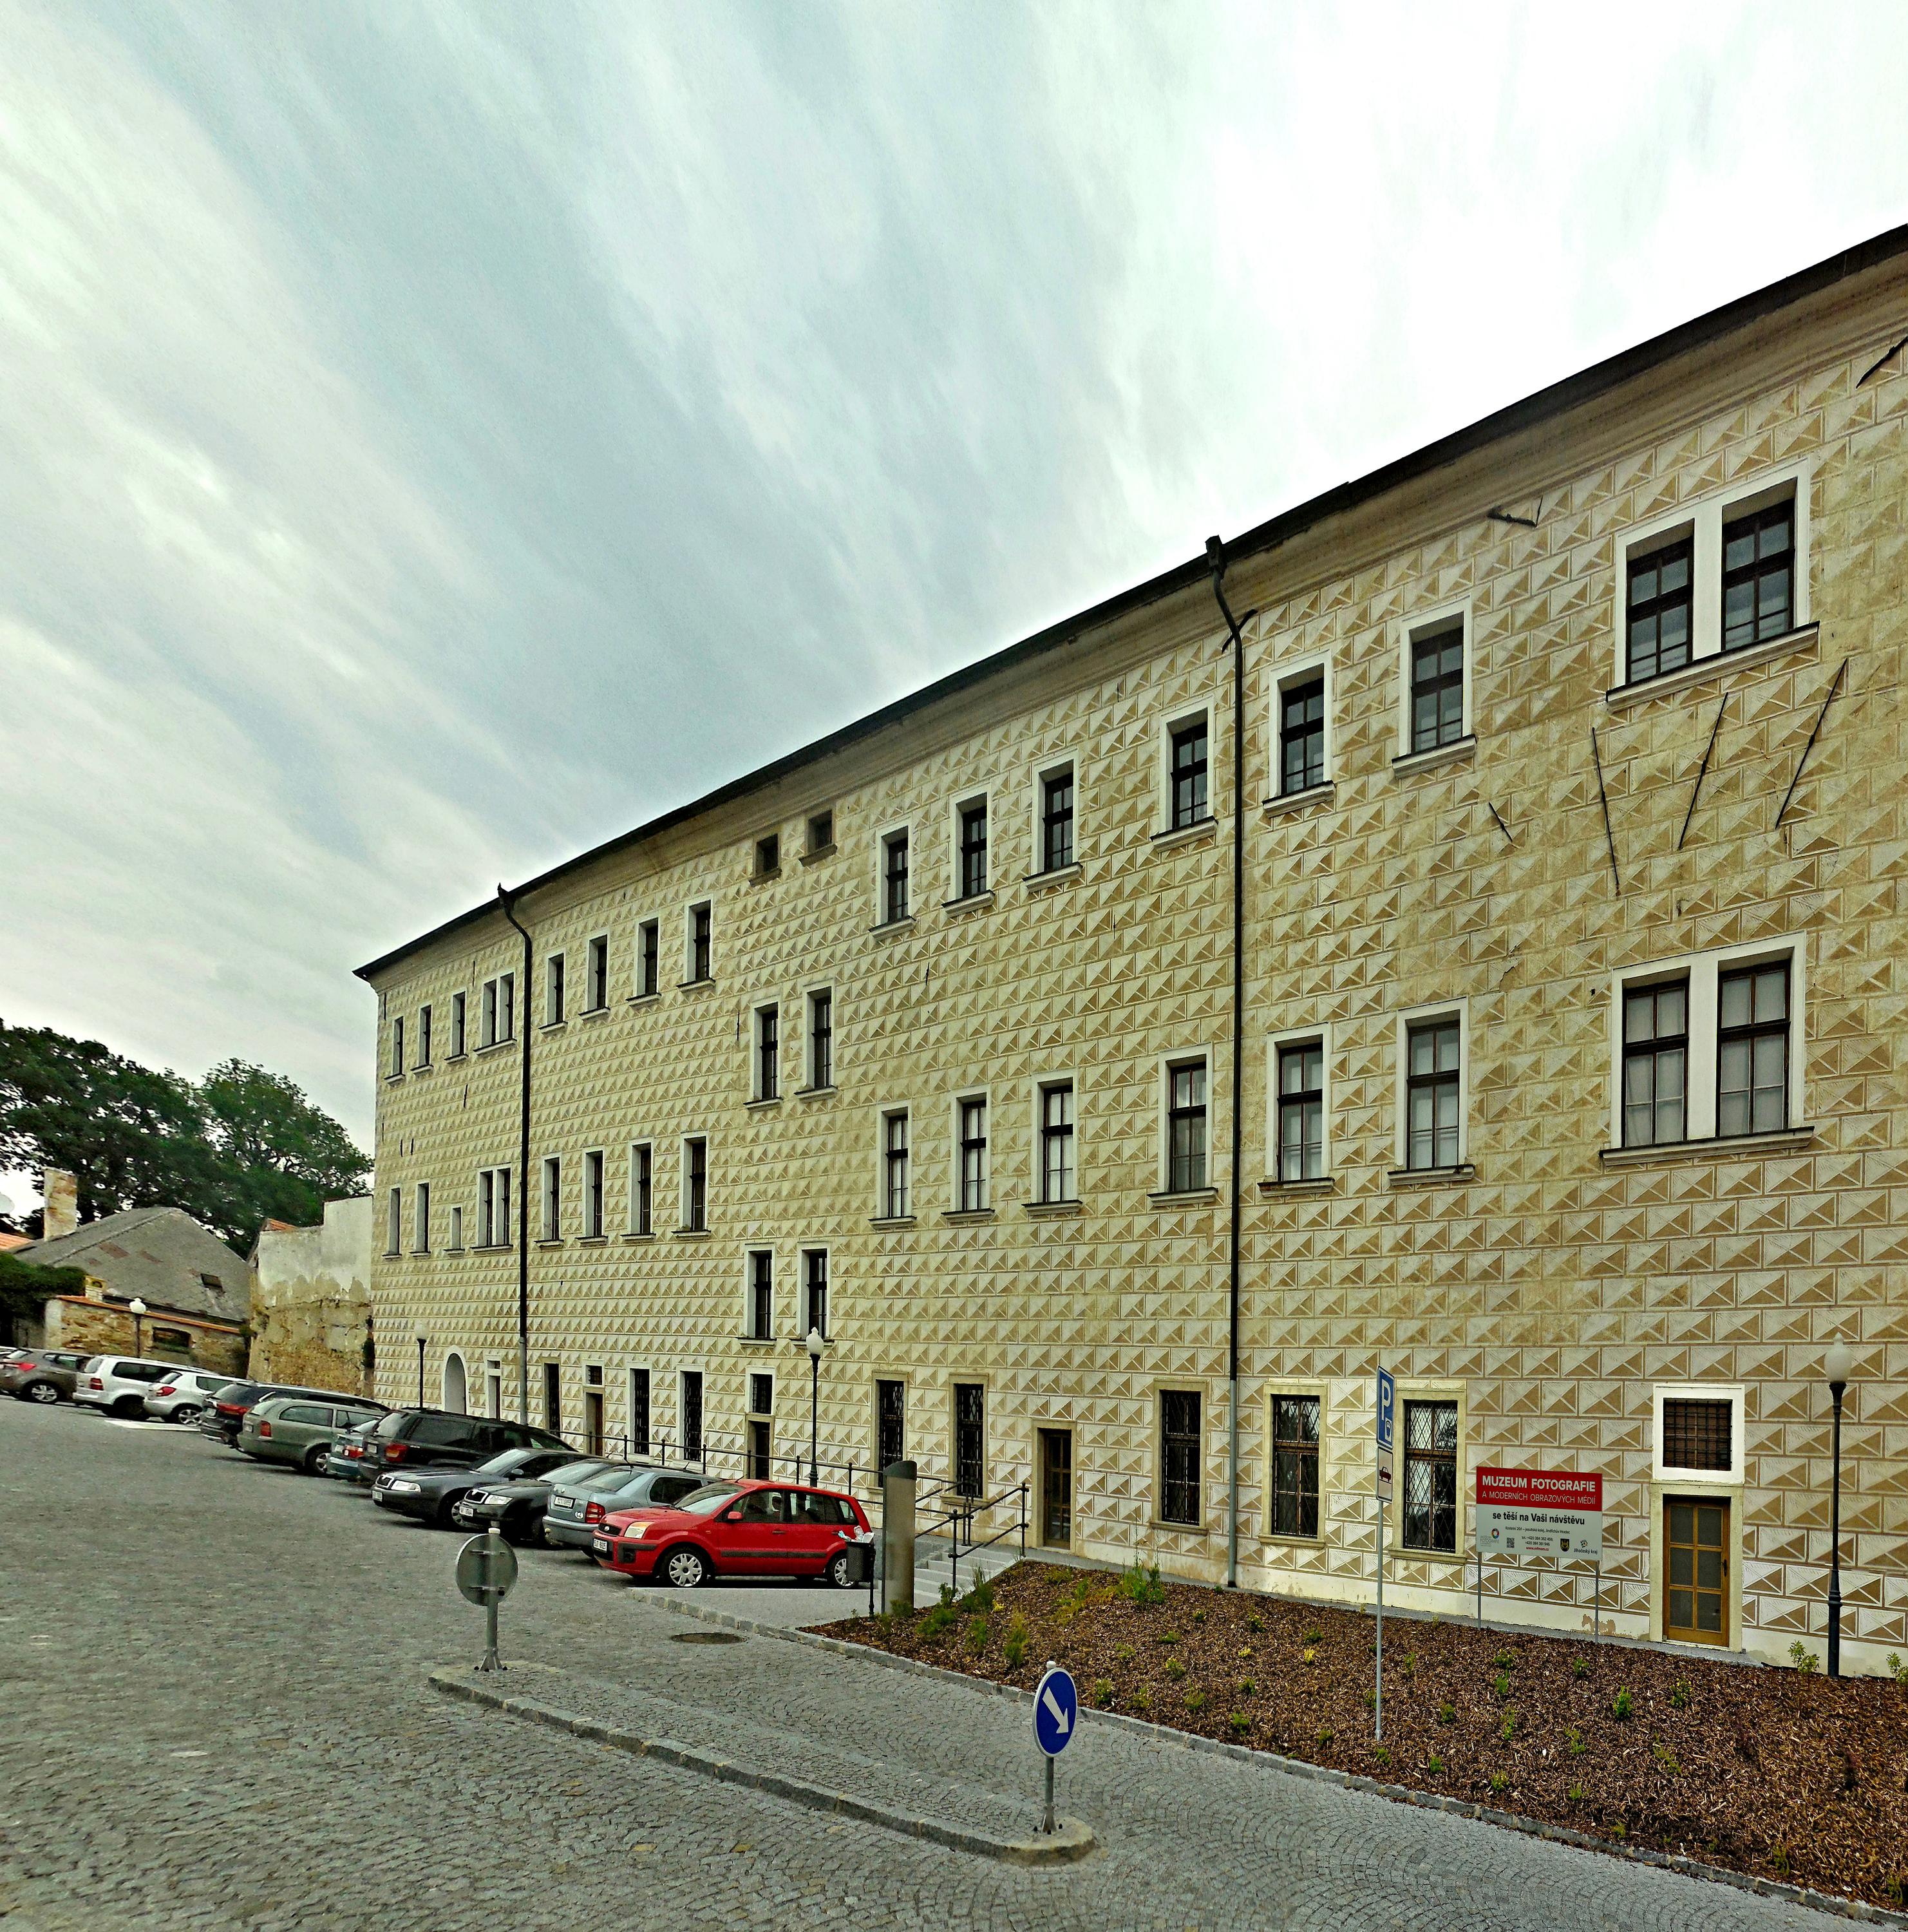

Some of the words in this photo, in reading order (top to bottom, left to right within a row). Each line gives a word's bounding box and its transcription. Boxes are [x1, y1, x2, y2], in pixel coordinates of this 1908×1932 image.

[1382, 1379, 1391, 1421] P
[1482, 1475, 1527, 1488] MUZEUM
[1531, 1479, 1595, 1492] FOTOGRAFIE
[1489, 1492, 1527, 1501] MODERNÍCH
[1531, 1493, 1574, 1503] OBRAZOVÝCH
[1578, 1496, 1595, 1504] MÉDIÍ
[1504, 1511, 1517, 1520] těší
[1531, 1513, 1547, 1522] Vaši
[1549, 1515, 1585, 1525] návštěvu
